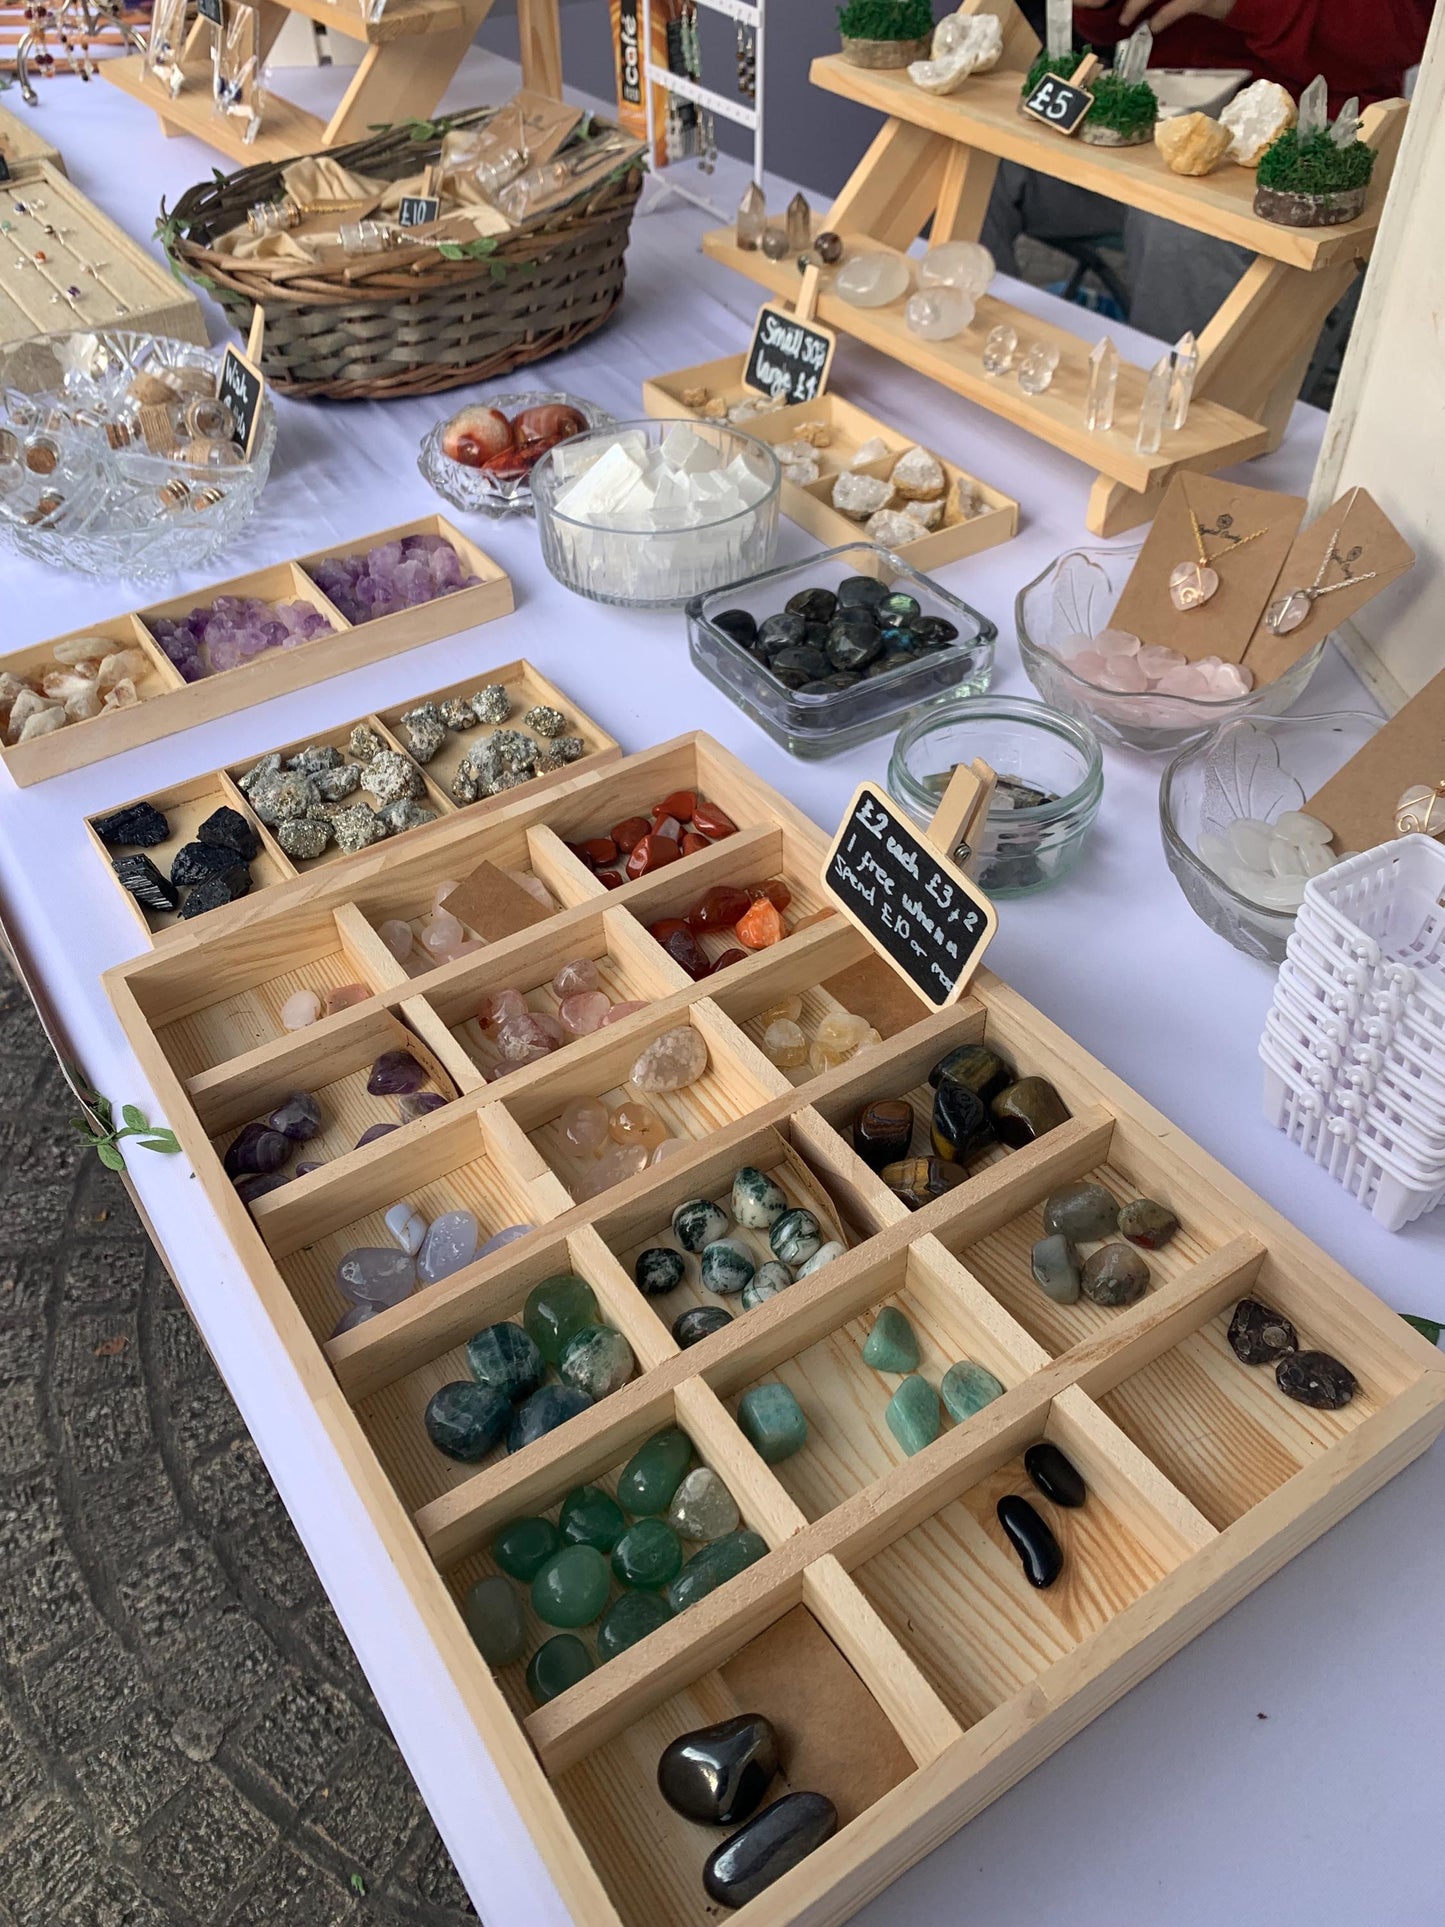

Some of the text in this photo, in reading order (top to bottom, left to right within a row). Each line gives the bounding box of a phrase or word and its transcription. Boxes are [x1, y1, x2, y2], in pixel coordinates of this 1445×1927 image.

[1028, 82, 1074, 119] £5
[400, 200, 427, 226] £10
[760, 316, 805, 360] Small
[226, 355, 249, 404] Wish
[792, 371, 818, 402] £1
[847, 833, 858, 853] 1
[856, 851, 896, 895] free
[856, 799, 889, 840] £2
[886, 835, 919, 880] each
[925, 872, 954, 909] £3
[963, 911, 979, 933] 2
[881, 902, 911, 939] £10
[910, 940, 928, 957] or
